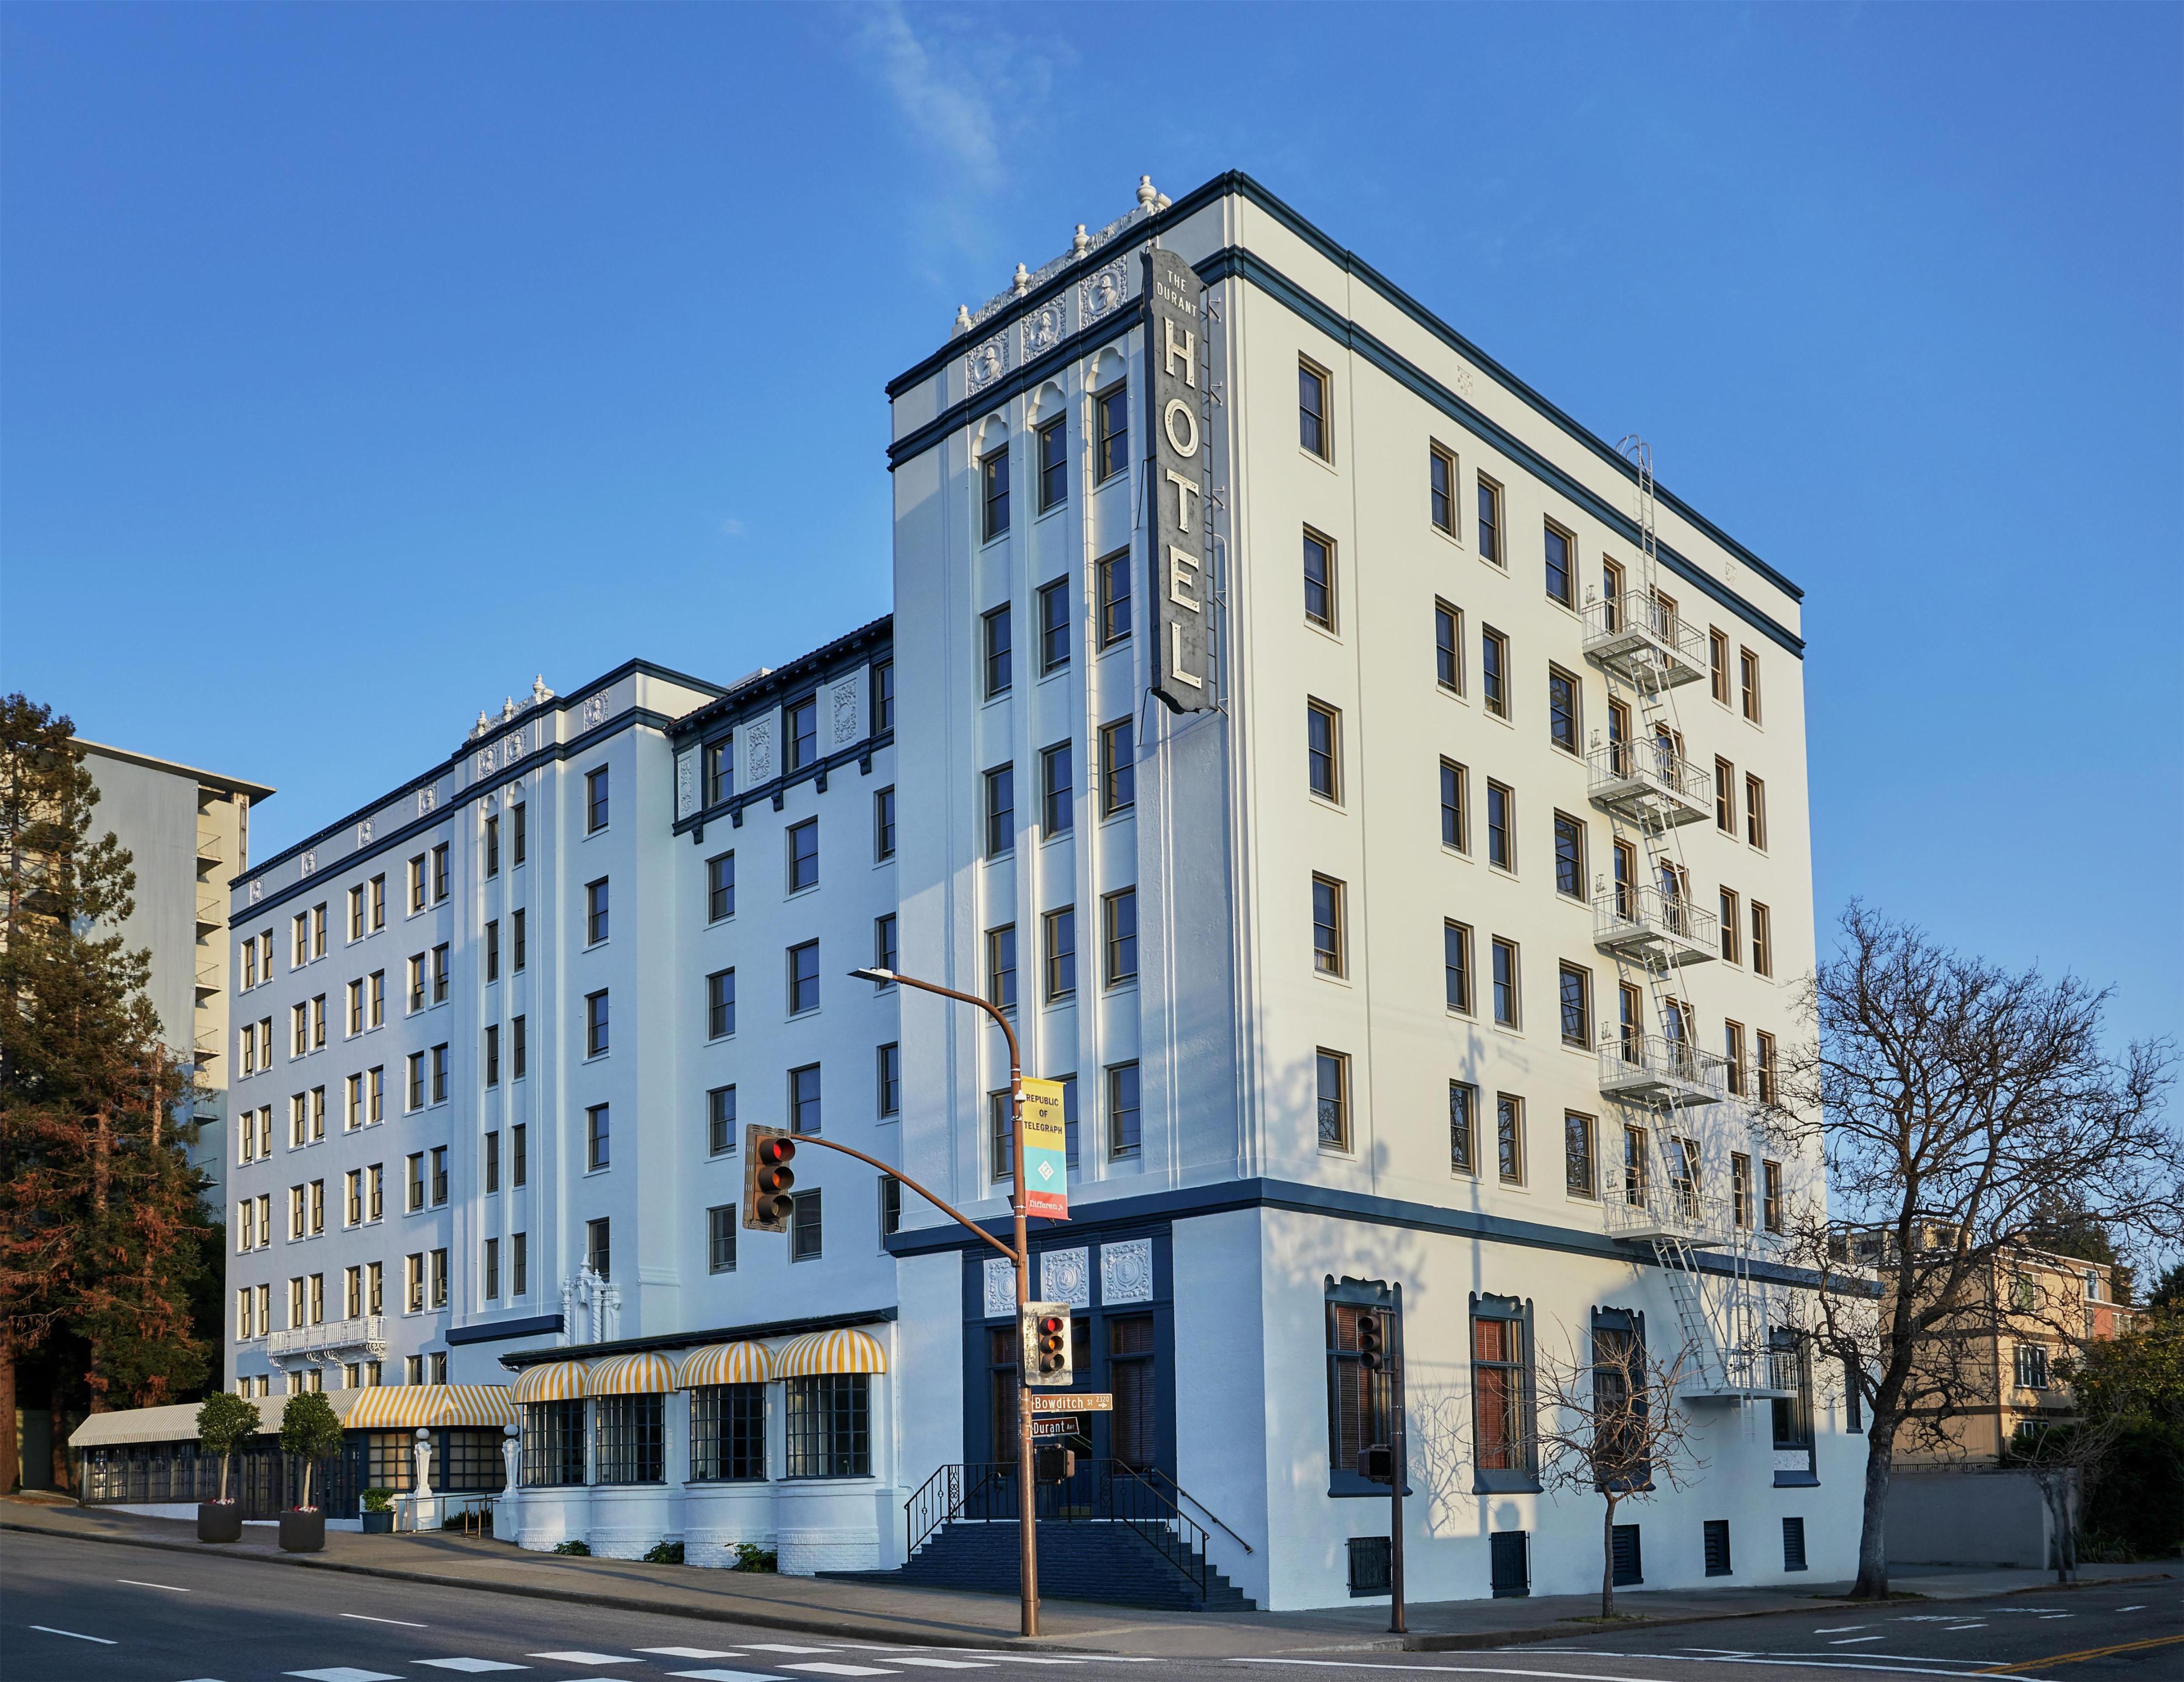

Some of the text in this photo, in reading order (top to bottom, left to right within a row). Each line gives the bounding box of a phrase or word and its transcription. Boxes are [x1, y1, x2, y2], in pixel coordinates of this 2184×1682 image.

[1167, 270, 1186, 293] THE
[1157, 282, 1197, 317] DURANT
[1163, 317, 1202, 689] HOTEL
[1026, 1094, 1059, 1106] REPUBLIC
[1039, 1109, 1048, 1118] OF
[1024, 1121, 1062, 1135] TELEGRAPH
[1035, 1397, 1083, 1409] Bowditch
[1033, 1420, 1065, 1434] Durant
